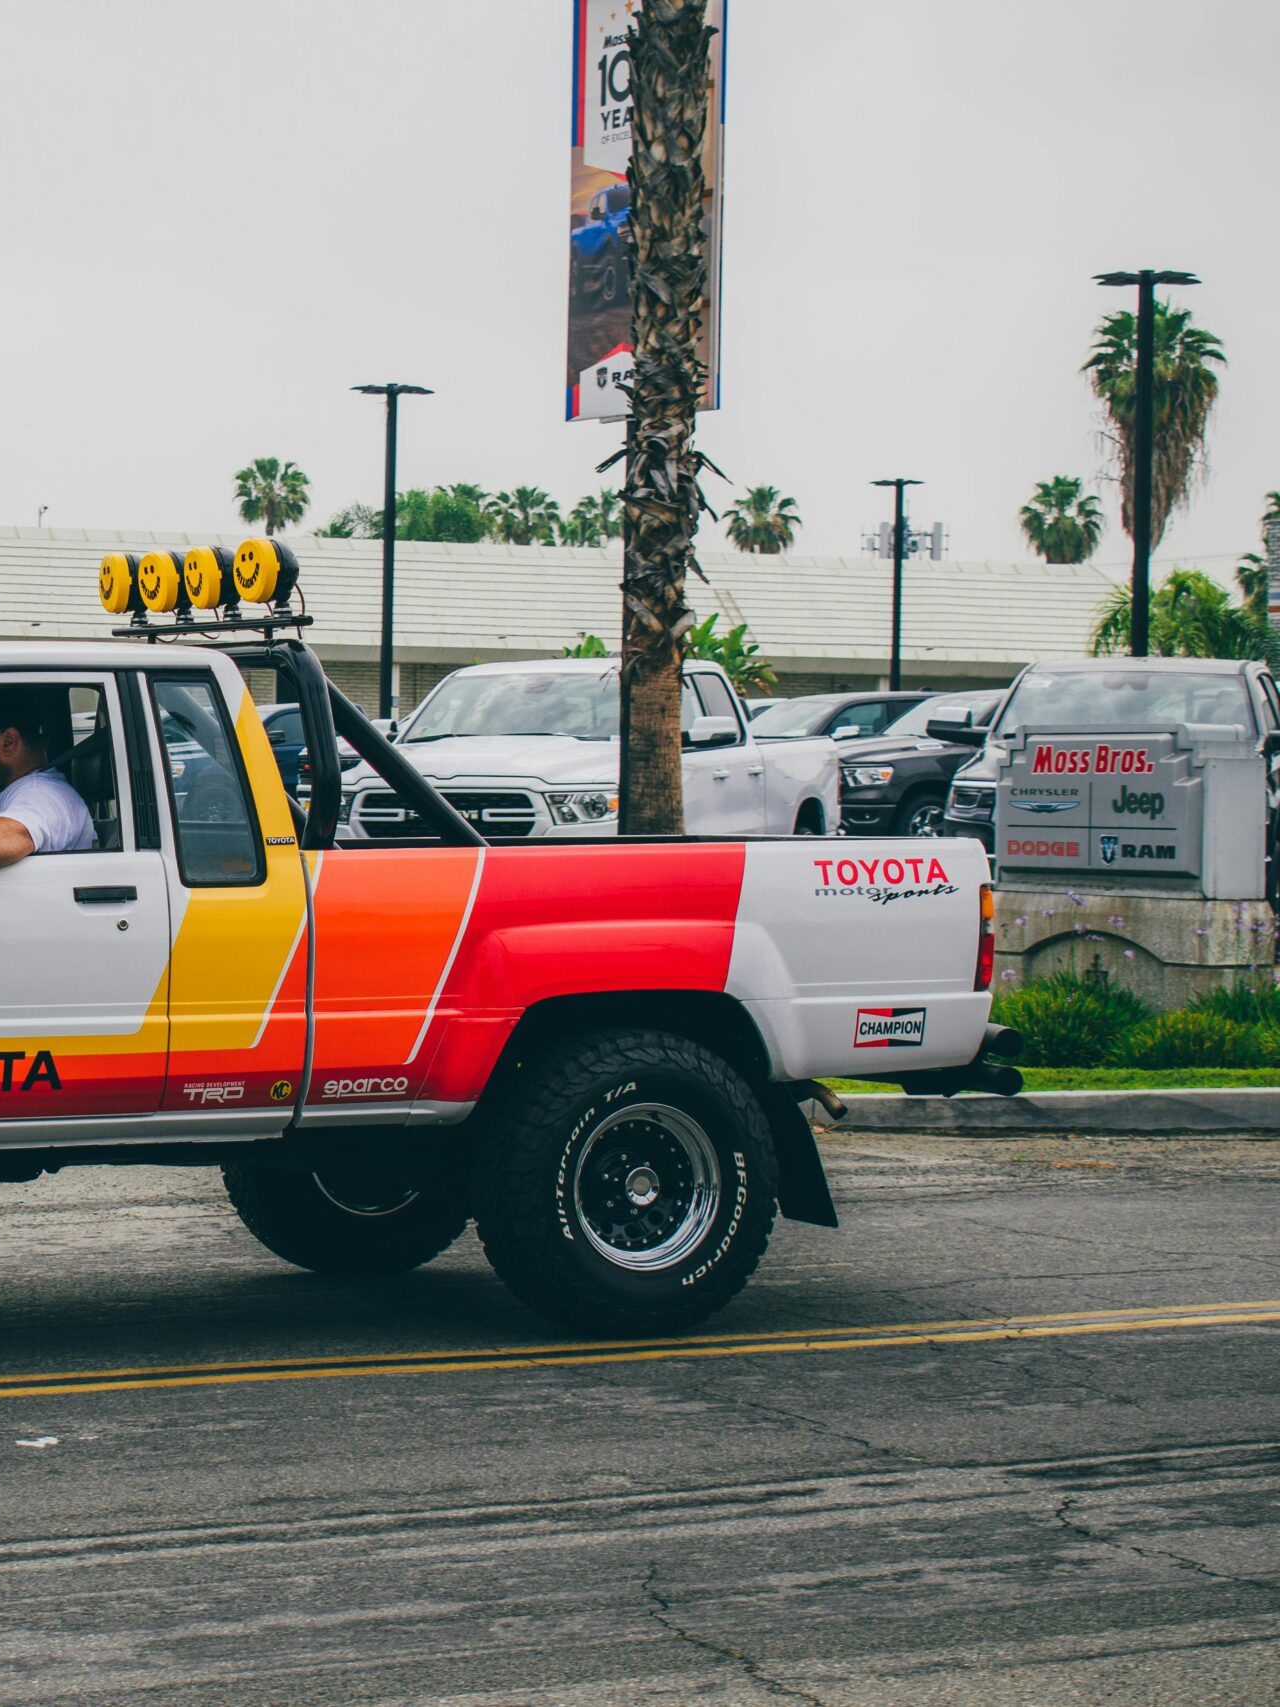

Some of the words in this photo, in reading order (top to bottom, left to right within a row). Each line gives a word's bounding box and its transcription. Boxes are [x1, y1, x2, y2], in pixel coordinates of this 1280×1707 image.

[598, 50, 632, 106] 10
[600, 106, 635, 131] YEA
[612, 369, 634, 382] RA
[1032, 744, 1091, 775] Moss
[1094, 745, 1156, 775] Bros.
[1010, 788, 1079, 796] CHRYSLER
[1112, 785, 1165, 820] Jeep
[1007, 840, 1080, 857] DODGE
[1121, 844, 1176, 860] RAM
[813, 858, 949, 886] TOYOTA
[815, 886, 892, 896] motor
[868, 884, 960, 905] sports
[860, 1020, 922, 1036] CHAMPION
[183, 1087, 244, 1104] TRD
[272, 1081, 290, 1100] KC
[323, 1076, 409, 1099] sparco
[555, 1106, 596, 1241] All-Terrain
[603, 1080, 638, 1103] T/A
[681, 1150, 748, 1287] BFGoodrich
